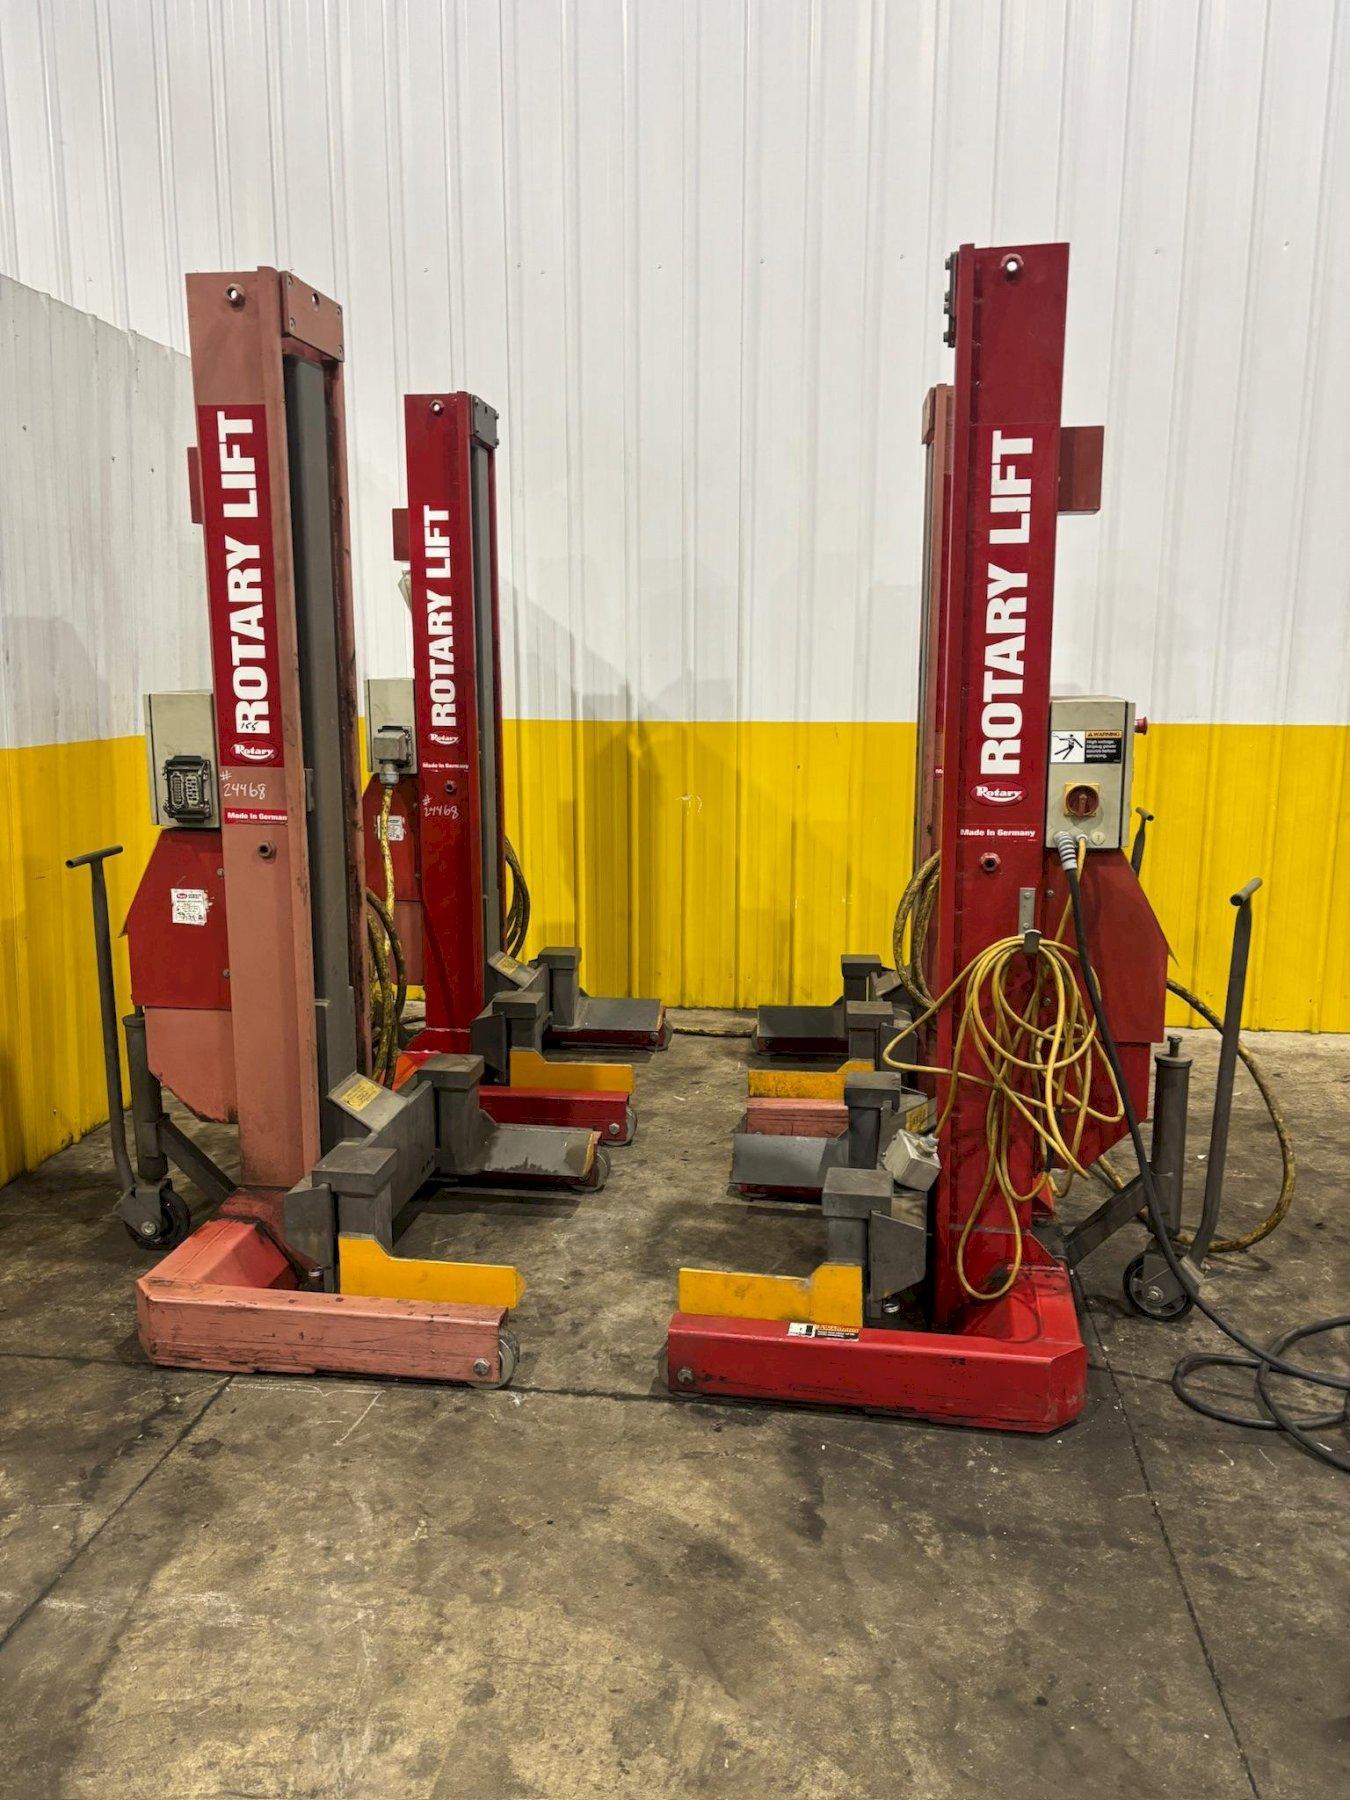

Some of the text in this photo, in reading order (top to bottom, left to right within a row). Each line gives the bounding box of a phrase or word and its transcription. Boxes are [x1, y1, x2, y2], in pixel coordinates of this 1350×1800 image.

[216, 410, 270, 734] ROTARY LIFT
[981, 430, 1034, 775] ROTARY LIFT
[424, 504, 457, 727] ROTARY LIFT
[430, 734, 459, 745] Rotary
[233, 744, 274, 760] Rotary
[220, 770, 232, 780] #
[223, 782, 267, 800] 24468
[976, 786, 1023, 802] Rotary
[997, 829, 1036, 838] Germany
